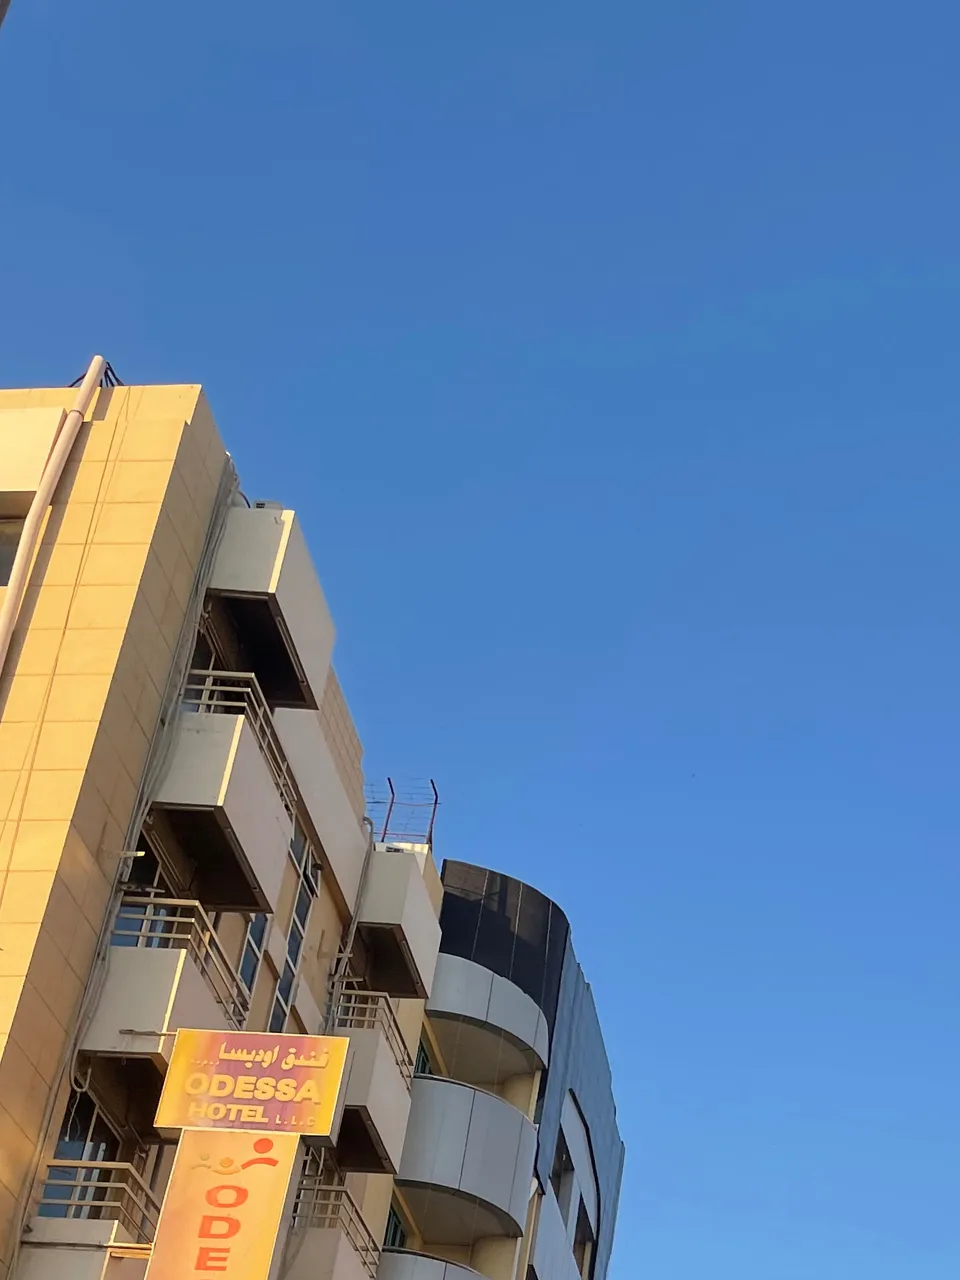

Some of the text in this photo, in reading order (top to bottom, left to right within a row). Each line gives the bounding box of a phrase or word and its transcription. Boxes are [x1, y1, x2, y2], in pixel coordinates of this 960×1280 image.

[281, 1048, 331, 1069] فندق
[184, 1072, 321, 1104] ODESSA
[188, 1101, 316, 1127] HOTEL L.L.C
